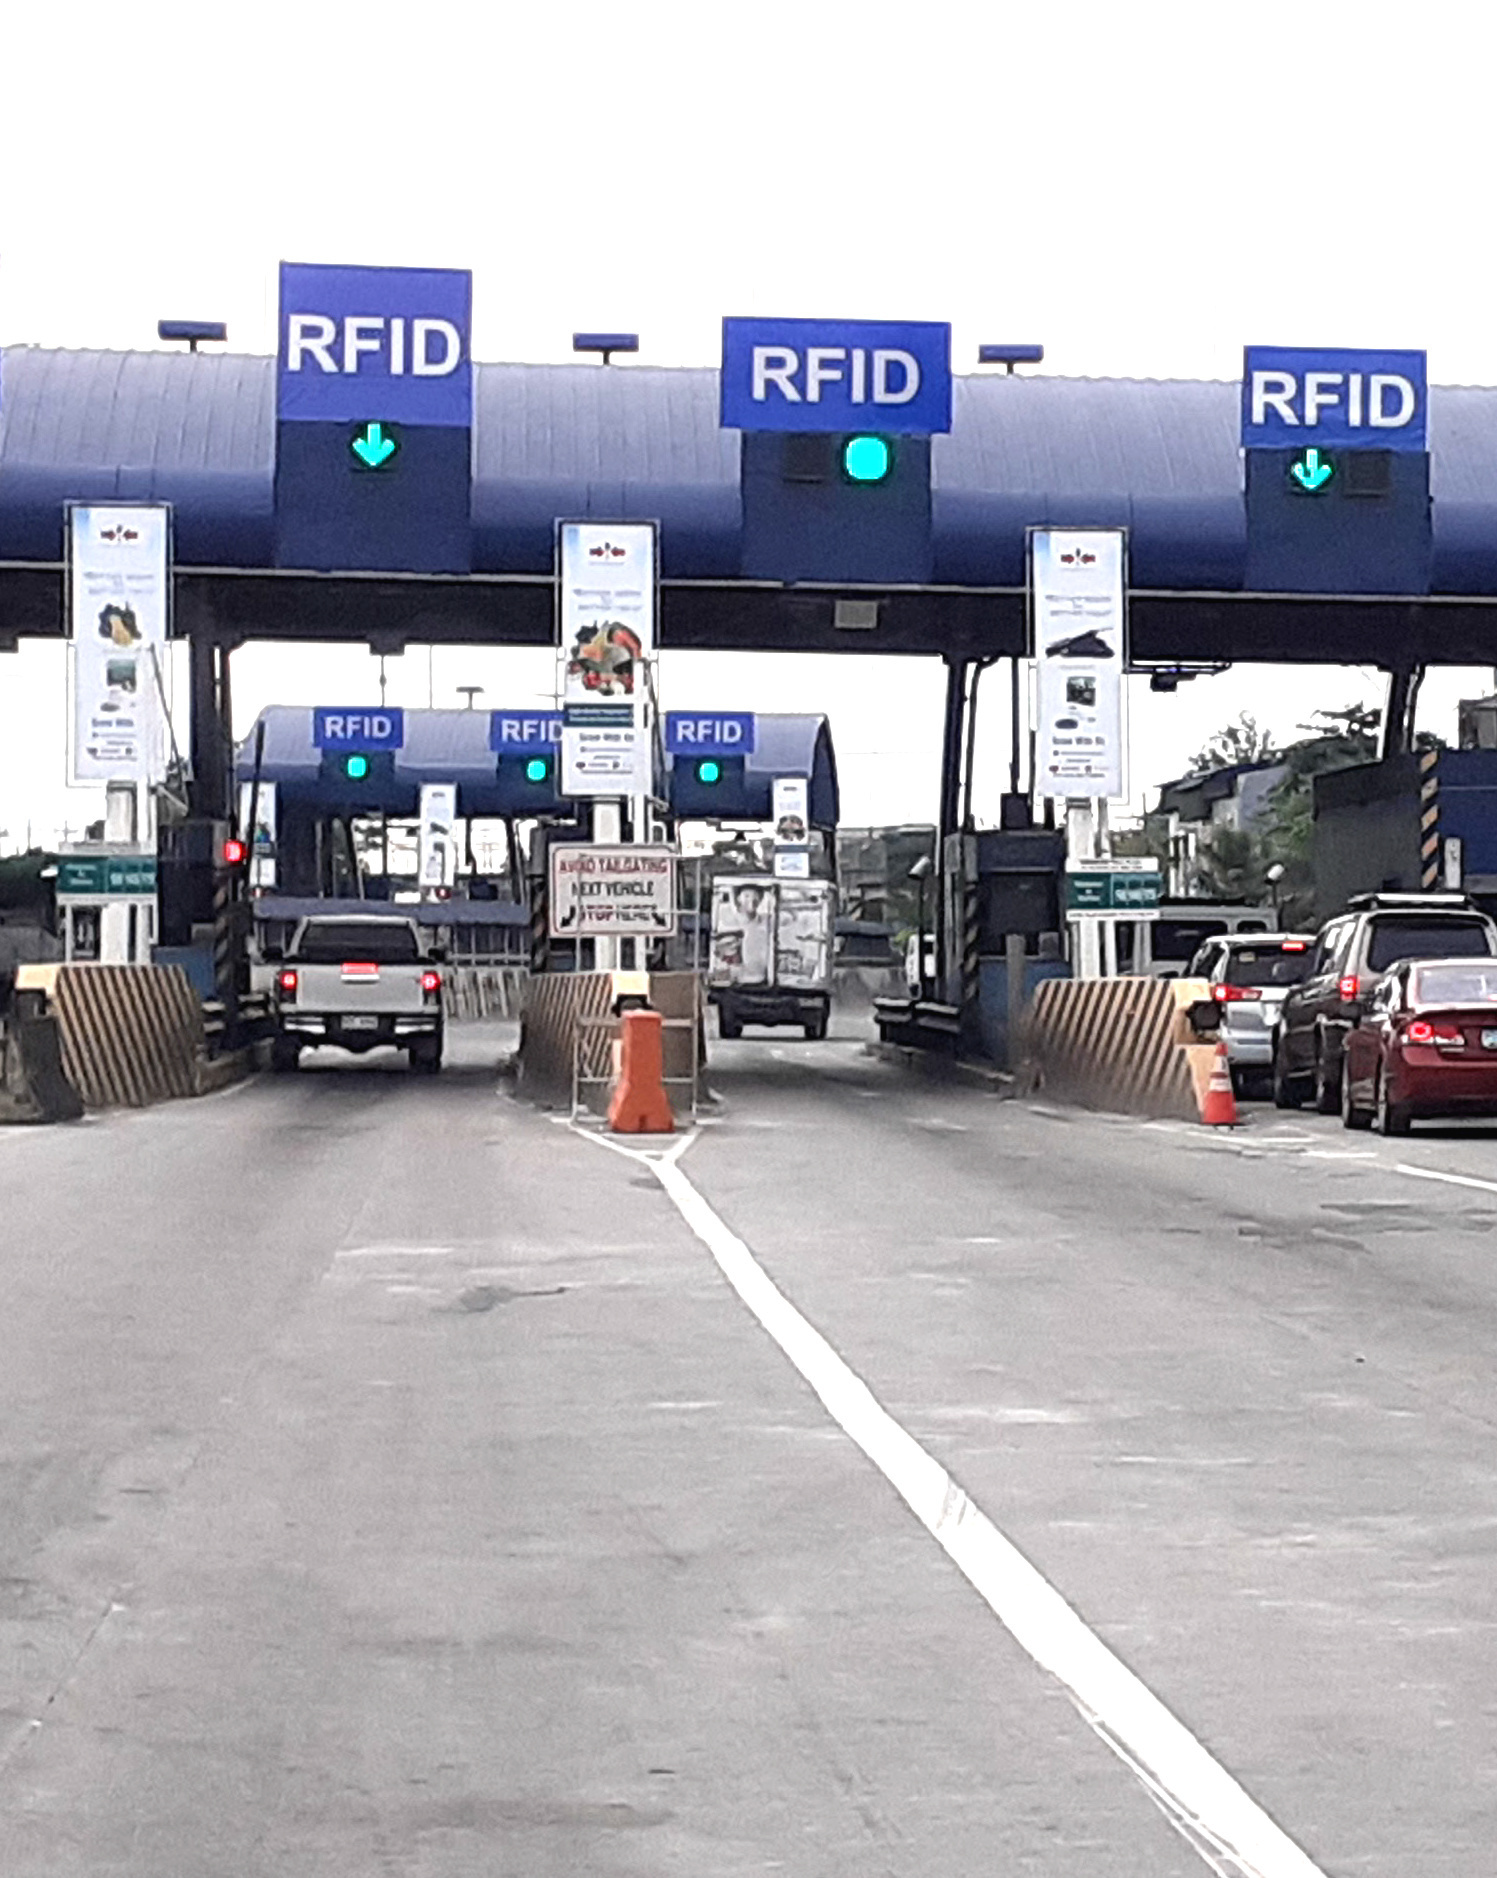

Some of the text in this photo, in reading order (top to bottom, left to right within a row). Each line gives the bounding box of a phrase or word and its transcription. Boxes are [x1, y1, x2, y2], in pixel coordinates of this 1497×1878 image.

[287, 315, 462, 376] RFID
[751, 346, 920, 405] RFID
[1251, 371, 1416, 428] RFID
[325, 715, 392, 738] RFID
[501, 718, 563, 743] RFID
[676, 719, 742, 744] RFID
